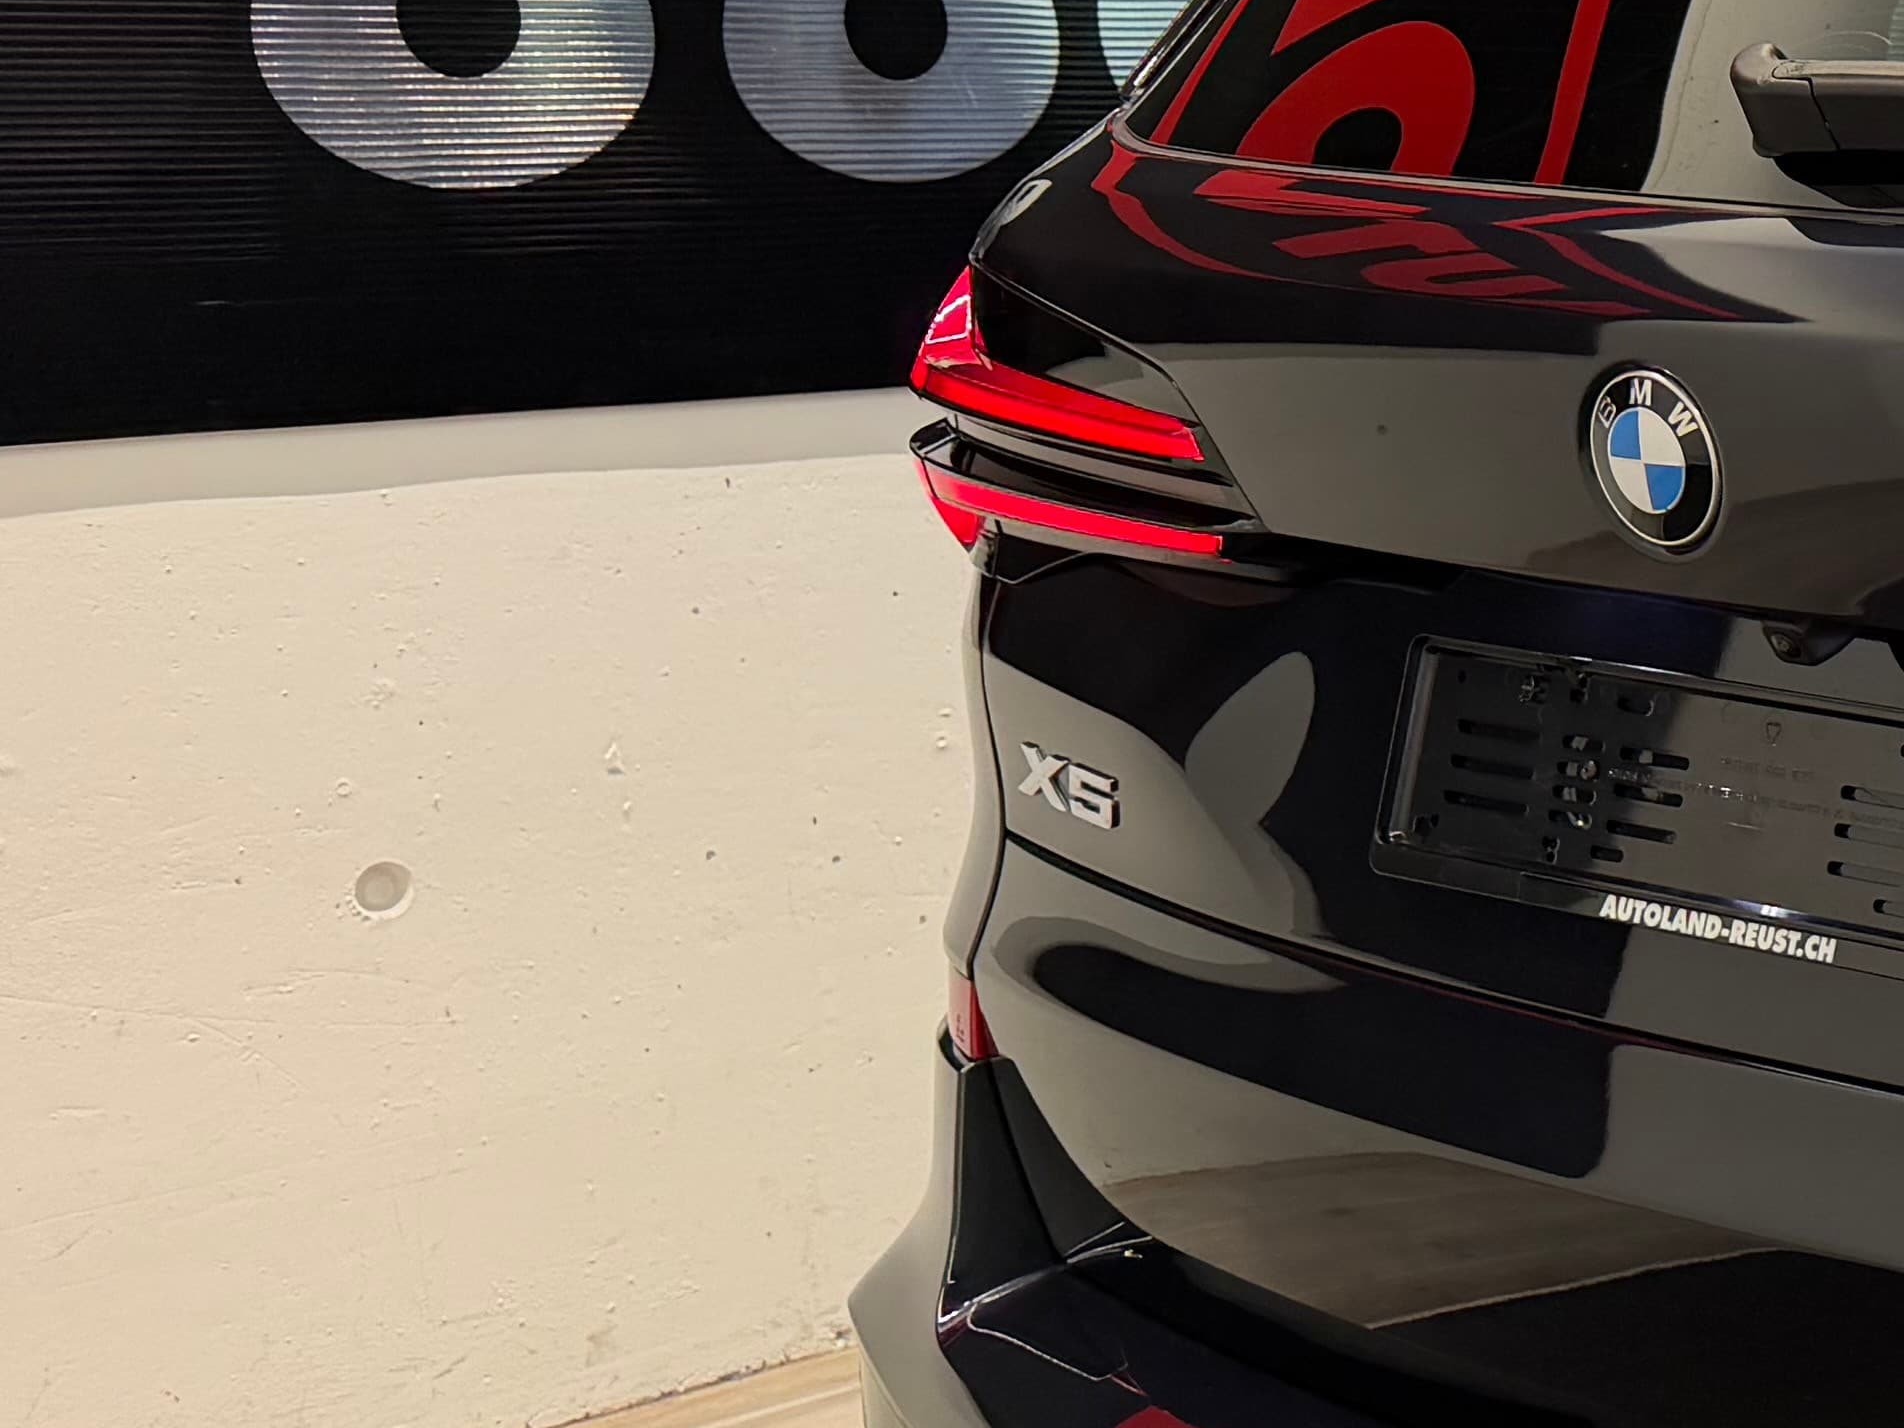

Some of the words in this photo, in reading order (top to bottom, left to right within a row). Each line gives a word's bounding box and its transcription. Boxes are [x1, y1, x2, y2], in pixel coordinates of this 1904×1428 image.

[1598, 378, 1699, 437] BMW
[1018, 741, 1121, 830] X5
[1599, 894, 1837, 964] AUTOLAND-REUST.CH
